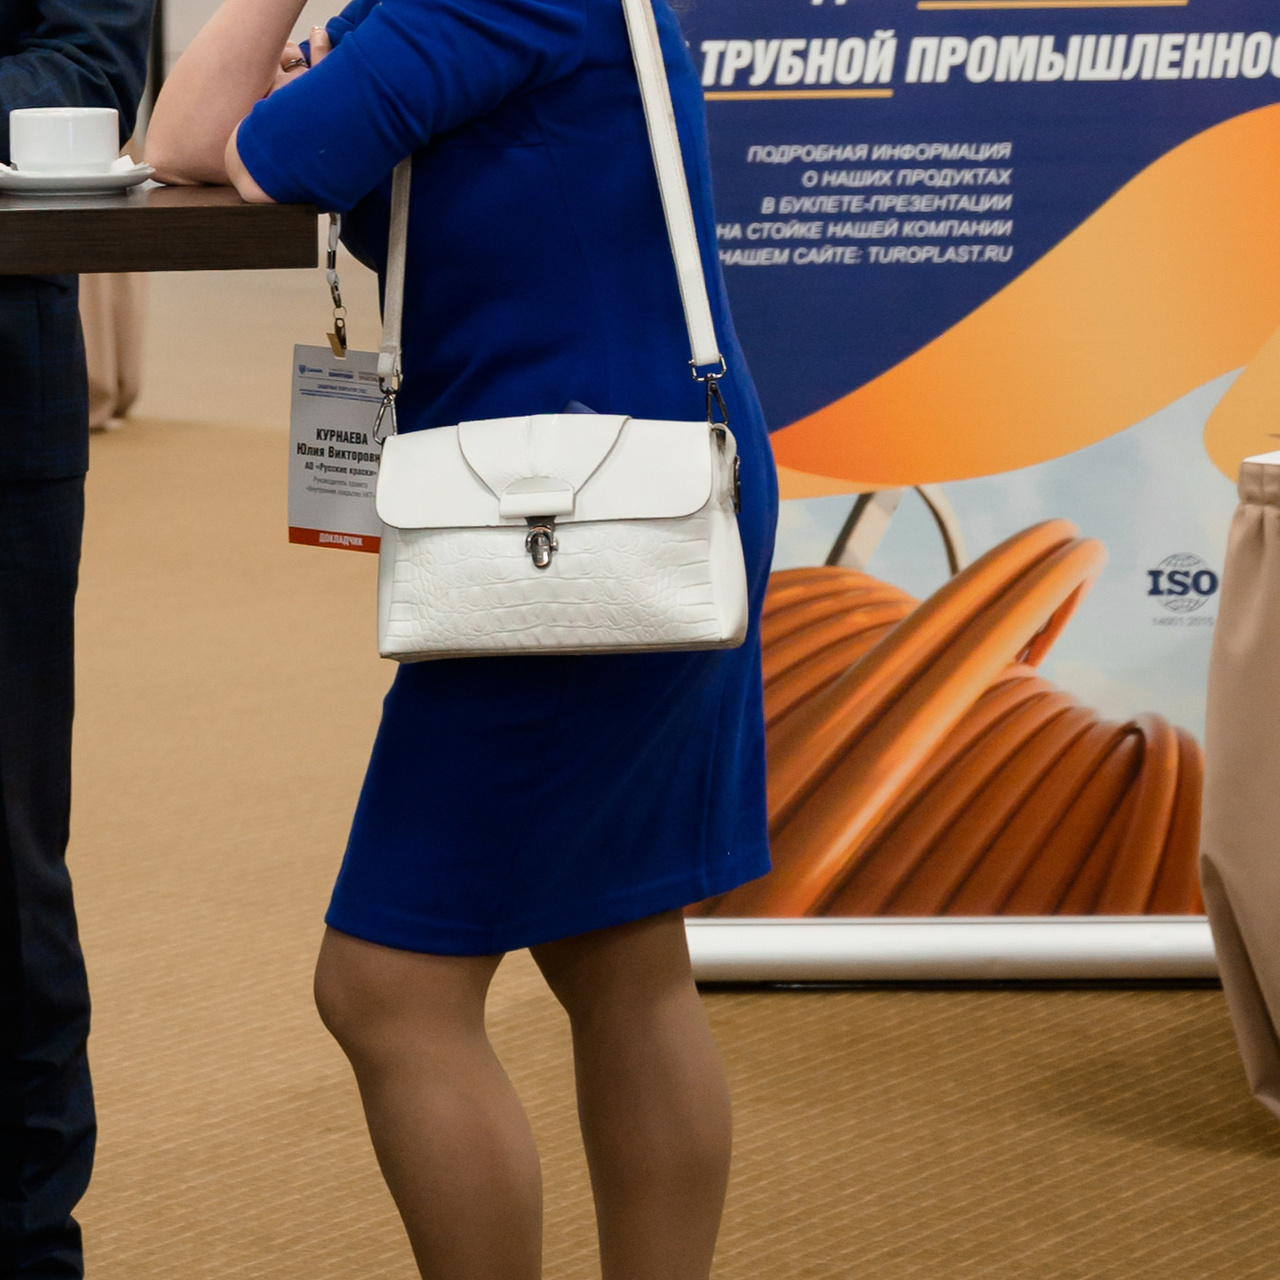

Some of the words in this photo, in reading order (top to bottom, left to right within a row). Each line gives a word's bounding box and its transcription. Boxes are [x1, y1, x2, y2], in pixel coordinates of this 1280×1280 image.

[701, 29, 897, 87] ТРУБНОЙ
[905, 31, 1280, 84] ПРОМЫШЛЕННО
[747, 144, 869, 164] ПОДРОБНАЯ
[871, 142, 1012, 162] ИНФОРМАЦИЯ
[801, 170, 819, 188] О
[822, 169, 894, 188] НАШИХ
[896, 167, 1014, 188] ПРОДУКТАХ
[760, 196, 776, 214] В
[746, 219, 823, 241] СТОЙКЕ
[826, 218, 900, 239] НАШЕЙ
[902, 219, 1014, 239] КОМПАНИИ
[868, 245, 1014, 265] TUROPLAST.RU
[316, 428, 368, 445] КУРНАЕВА
[296, 442, 325, 457] Юлия
[328, 446, 381, 464] Викторовн
[1147, 570, 1219, 596] ISO
